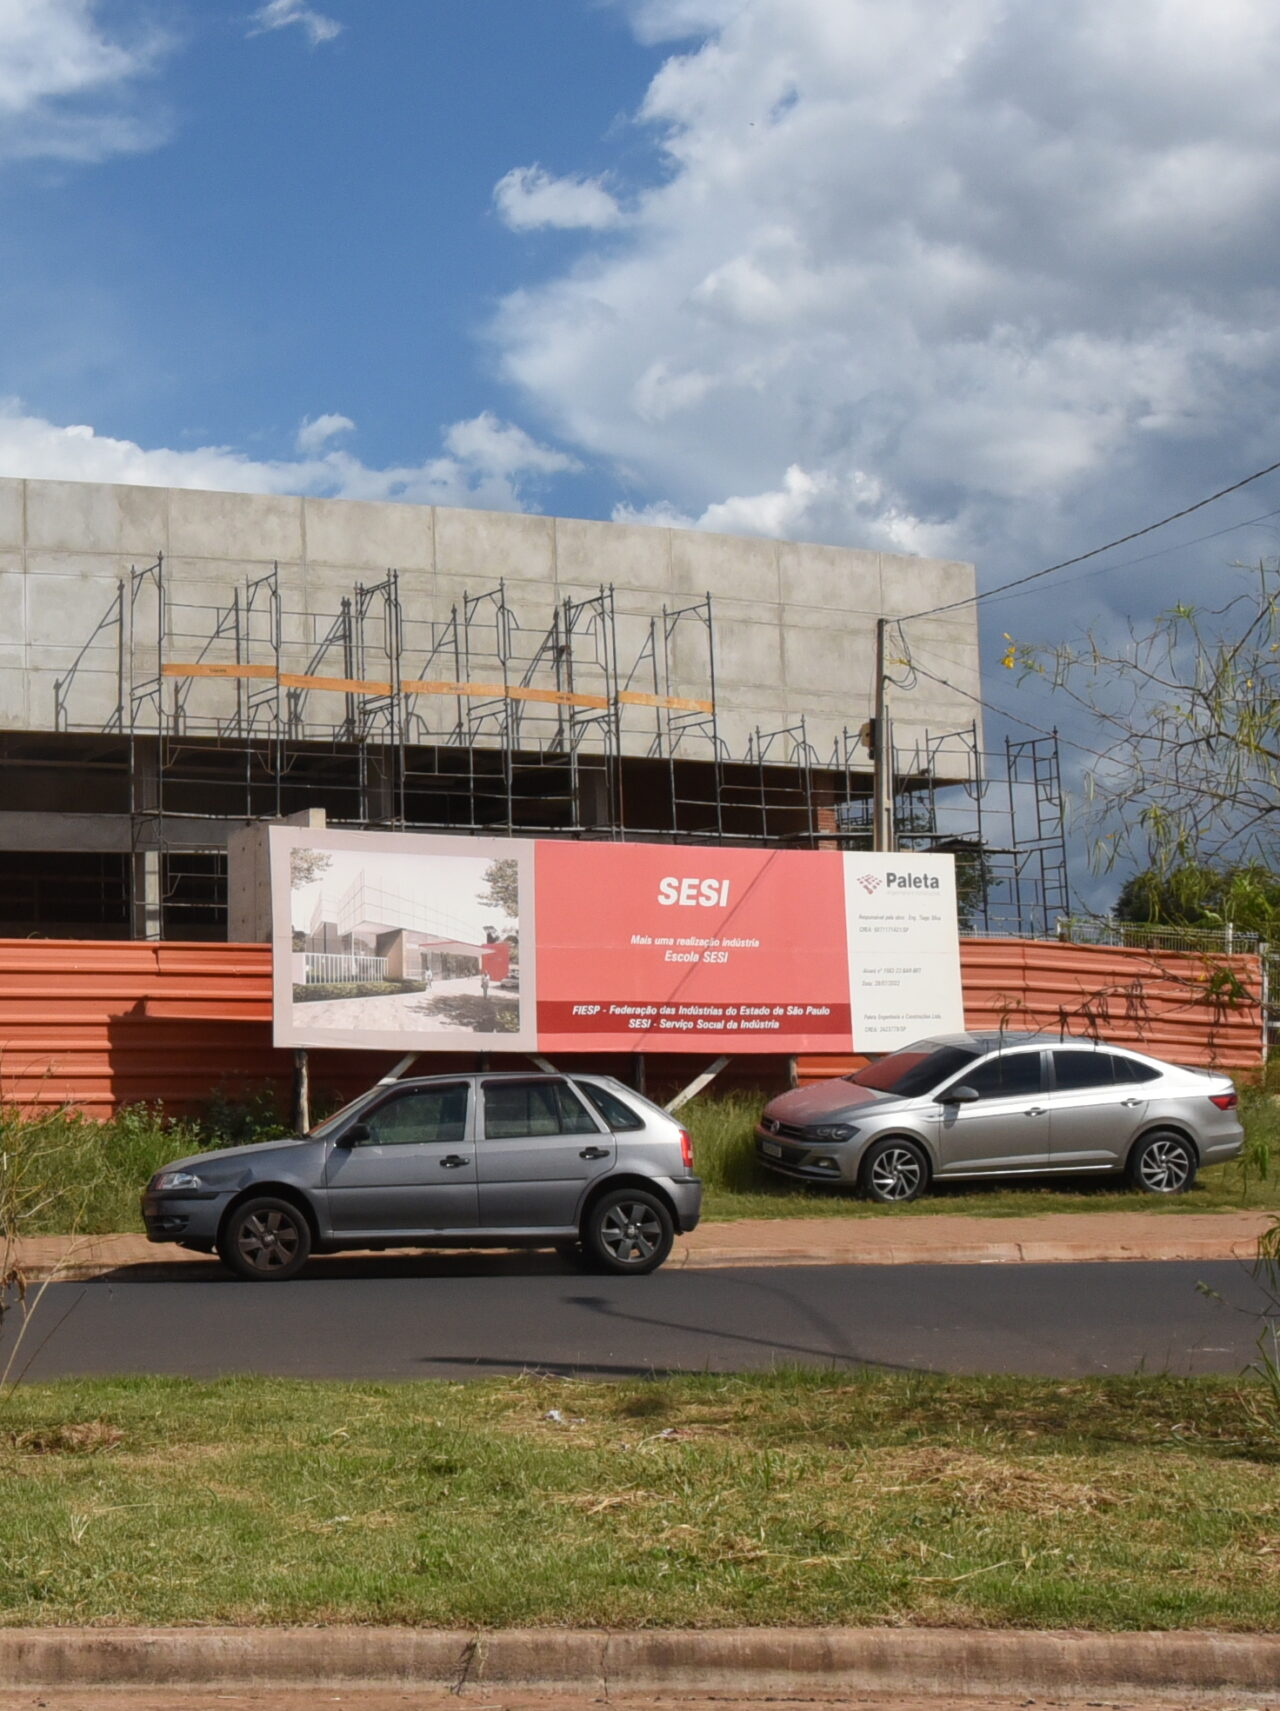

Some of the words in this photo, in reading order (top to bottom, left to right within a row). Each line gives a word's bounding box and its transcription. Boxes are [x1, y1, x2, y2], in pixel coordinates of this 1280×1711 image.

[886, 872, 939, 889] Paleta
[657, 877, 730, 907] SESI
[631, 935, 652, 945] Mais
[655, 938, 674, 946] uma
[676, 937, 720, 948] realização
[722, 937, 760, 948] indústria
[664, 950, 699, 962] Escola
[703, 951, 728, 963] SESI
[572, 1005, 601, 1015] FIESP
[609, 1005, 657, 1016] Federação
[659, 1006, 676, 1015] das
[678, 1005, 723, 1016] Indústrias
[725, 1006, 738, 1015] do
[739, 1006, 771, 1015] Estado
[772, 1006, 784, 1015] de
[786, 1005, 804, 1015] São
[806, 1006, 830, 1016] Paulo
[628, 1018, 651, 1028] SESI
[659, 1019, 694, 1030] Serviço
[696, 1019, 725, 1029] Social
[727, 1020, 738, 1029] da
[740, 1020, 780, 1029] Indústria
